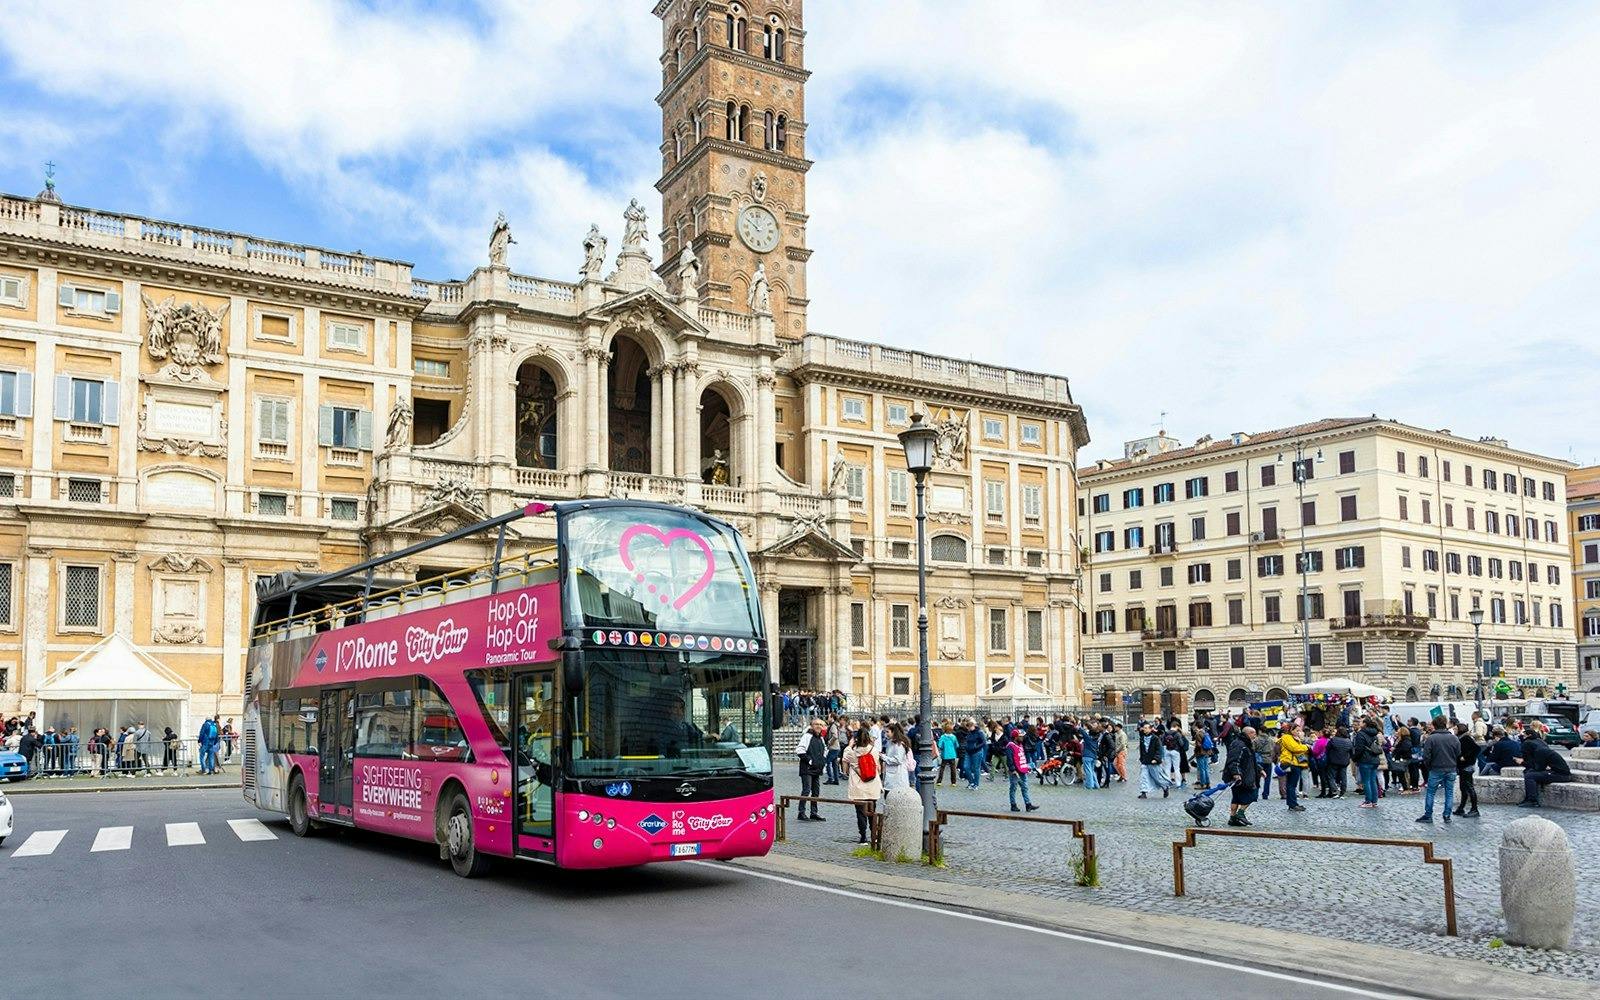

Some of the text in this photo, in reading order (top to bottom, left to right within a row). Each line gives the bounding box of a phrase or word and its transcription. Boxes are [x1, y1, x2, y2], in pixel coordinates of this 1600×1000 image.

[488, 593, 538, 625] Hop-On
[405, 618, 469, 664] City Tour
[486, 618, 539, 651] Hop-Off
[335, 637, 398, 673] I Rome
[485, 648, 537, 664] Panoramic Tour
[363, 765, 422, 790] SIGHTSEEING
[363, 785, 422, 809] EVERYWHERE
[687, 814, 733, 831] City Tour
